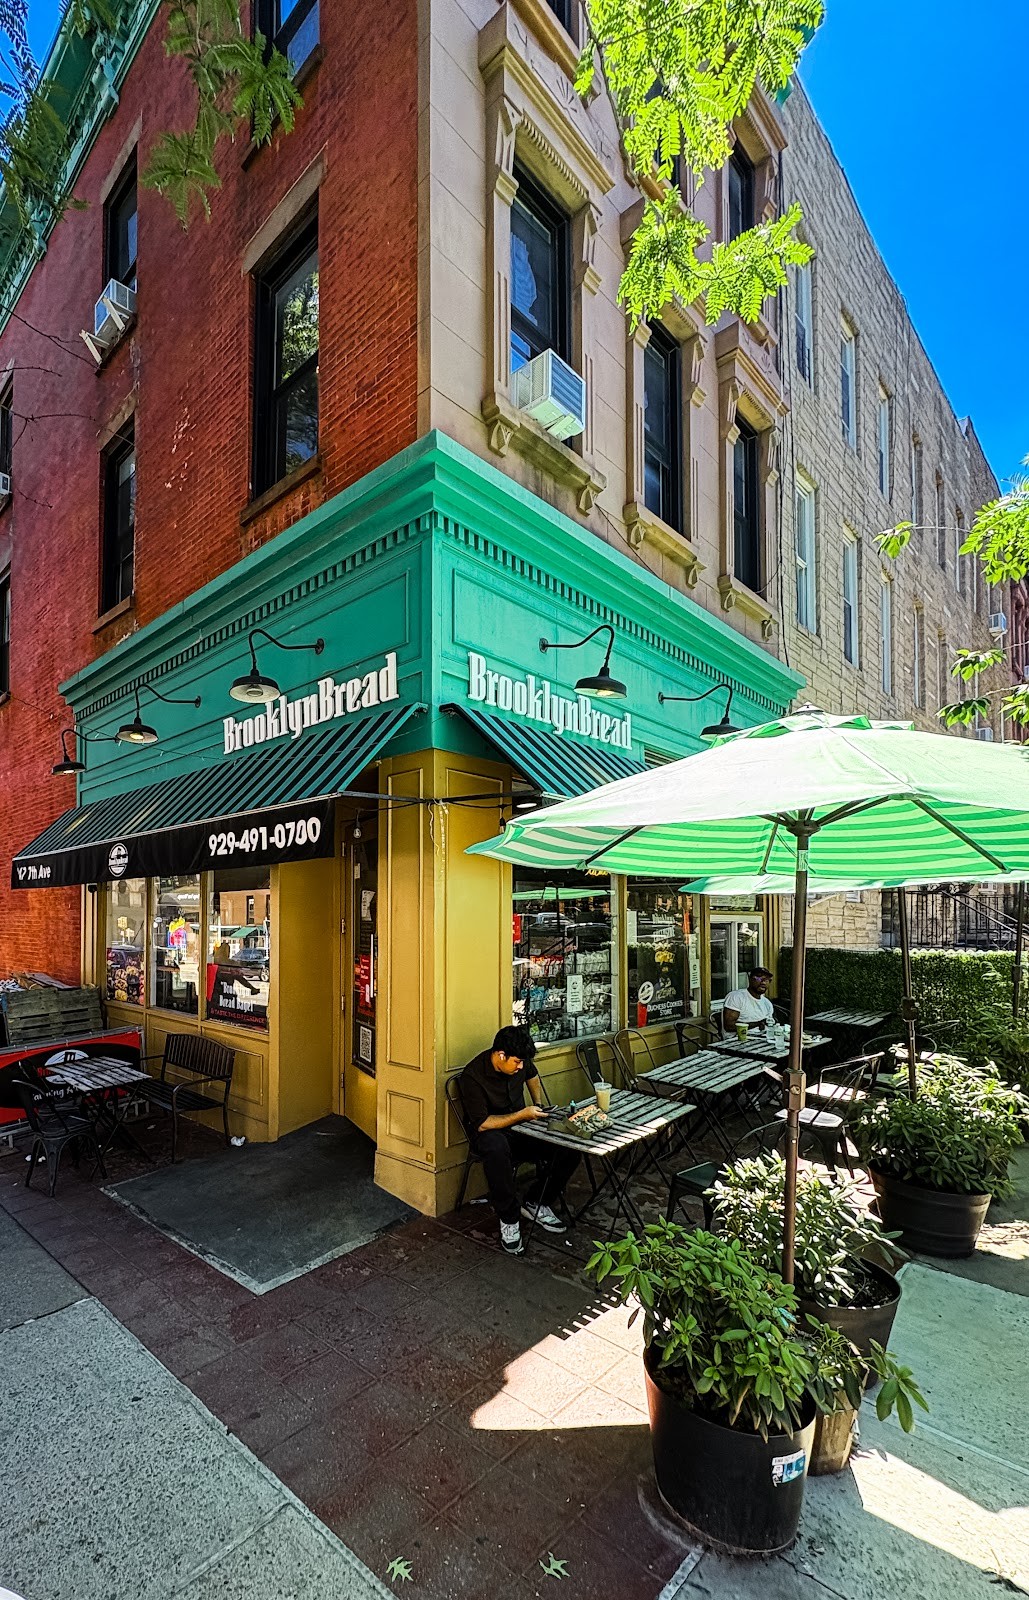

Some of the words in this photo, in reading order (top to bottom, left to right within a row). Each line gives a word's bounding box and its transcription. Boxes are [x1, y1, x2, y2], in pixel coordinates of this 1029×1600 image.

[208, 816, 321, 857] 929-491-0700
[27, 865, 37, 880] 7th
[38, 864, 51, 879] Ave
